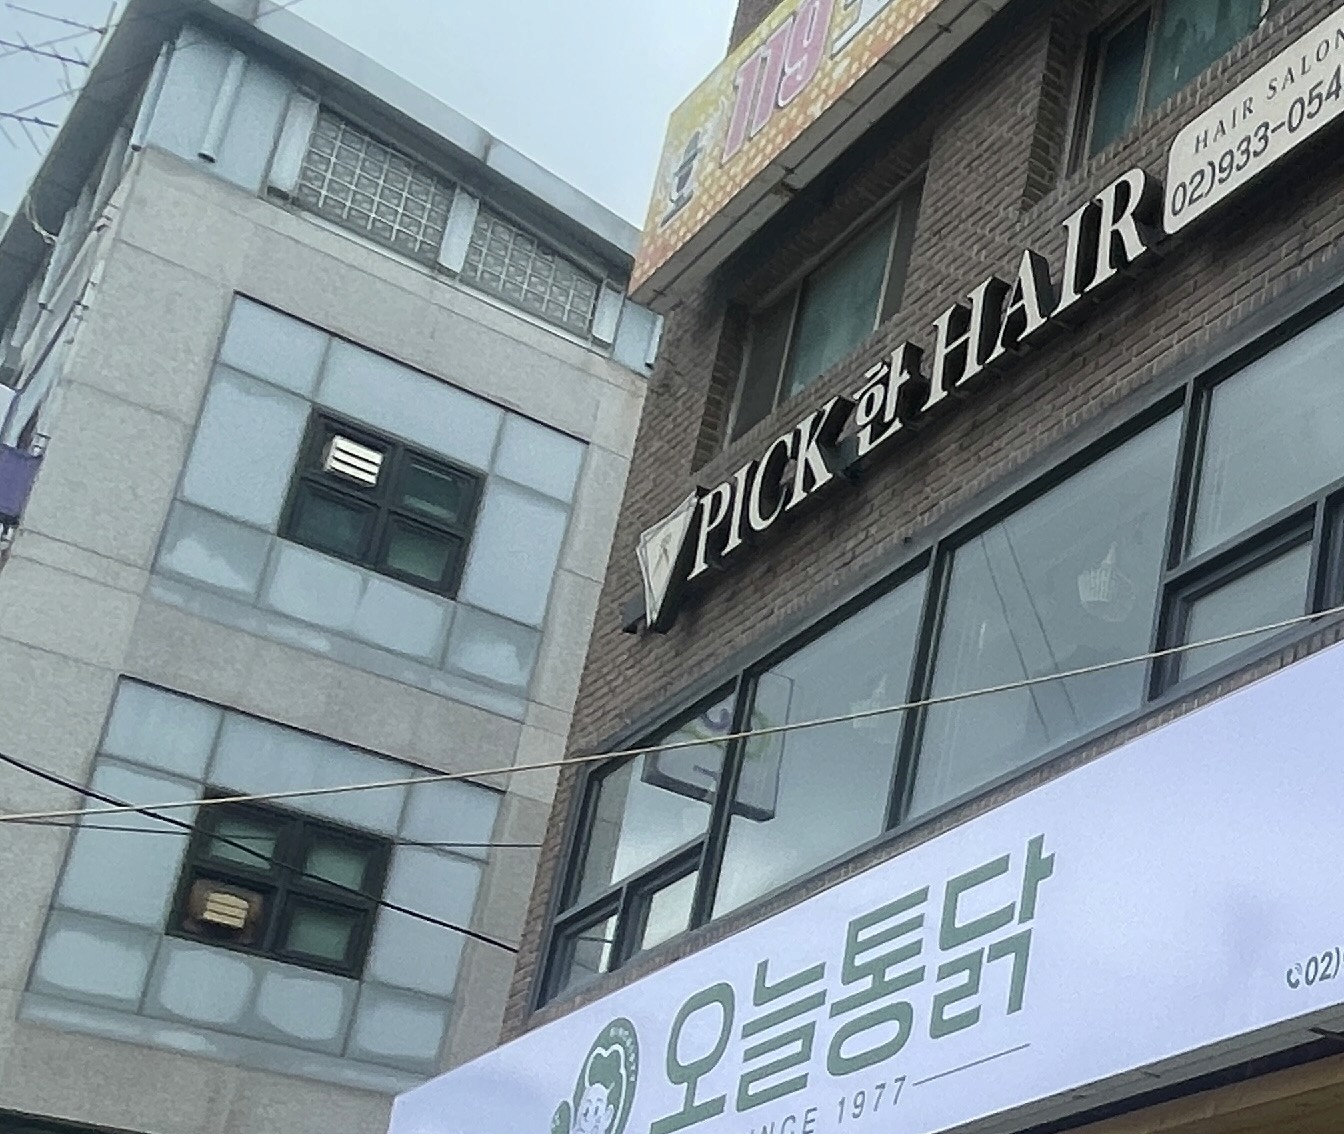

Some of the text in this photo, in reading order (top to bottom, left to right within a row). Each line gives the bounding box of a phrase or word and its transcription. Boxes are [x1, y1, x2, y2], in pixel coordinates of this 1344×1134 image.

[1193, 97, 1255, 154] HAIR
[687, 167, 1148, 581] PICK 한 HAIR
[837, 1077, 907, 1126] 1977
